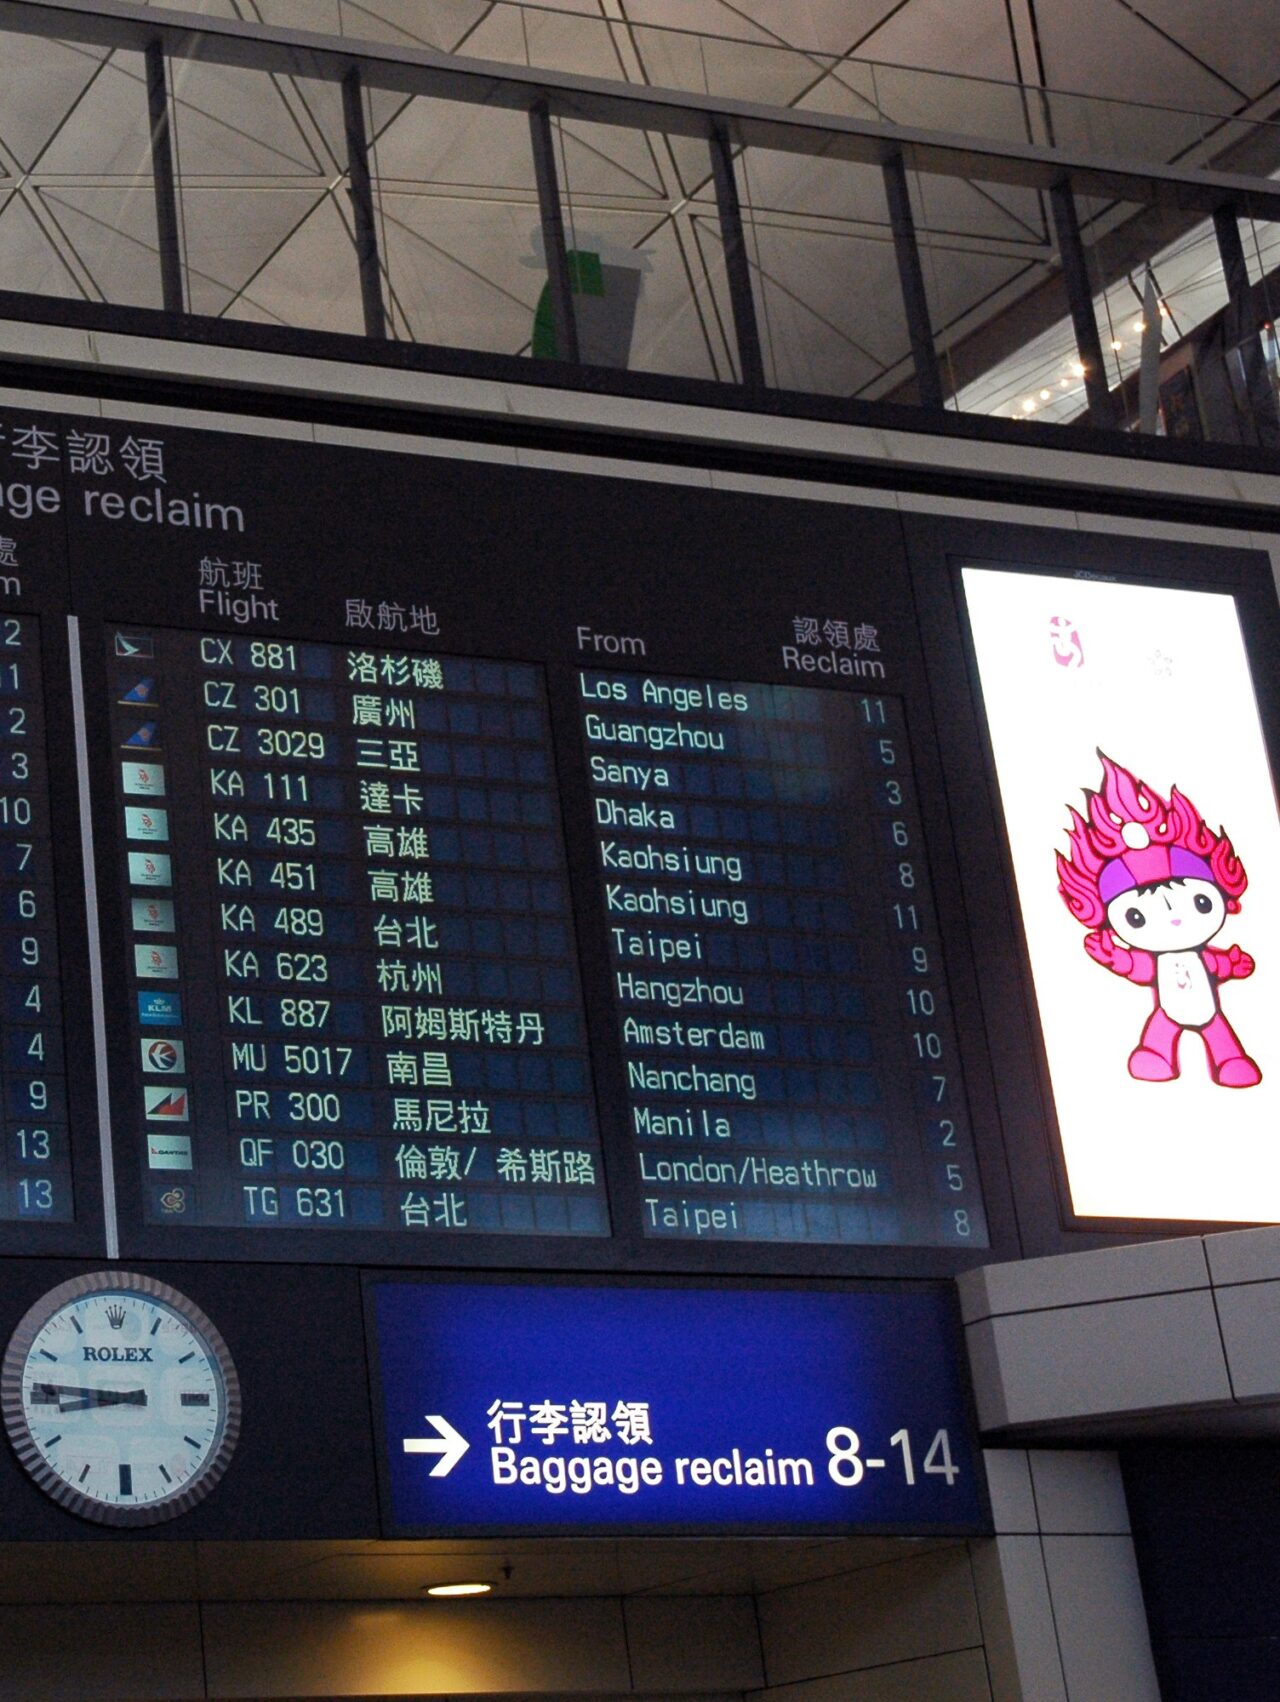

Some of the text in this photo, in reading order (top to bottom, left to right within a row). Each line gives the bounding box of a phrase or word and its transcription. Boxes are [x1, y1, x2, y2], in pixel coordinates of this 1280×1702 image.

[84, 488, 244, 532] reclaim
[199, 556, 264, 590] 航班
[199, 588, 279, 623] Flight
[577, 626, 646, 655] From
[792, 615, 881, 652] 認領處
[200, 638, 295, 671] CX 881
[347, 651, 444, 689] 洛杉磯
[782, 645, 885, 678] Reclaim
[204, 681, 299, 714] CZ 301
[580, 672, 748, 711] Los Angeles
[9, 707, 26, 735] 2
[352, 695, 415, 729] 廣州
[207, 724, 325, 759] CZ 3029
[585, 714, 724, 750] Guangzhou
[11, 752, 28, 779] 3
[357, 739, 420, 772] 三亞
[880, 740, 895, 764] 5
[211, 769, 307, 801] KA 111
[590, 756, 669, 790] Sanya
[360, 780, 423, 815] 達卡
[886, 781, 902, 805] 3
[0, 796, 31, 825] 10
[595, 798, 675, 829] Dhaka
[214, 812, 315, 846] KA 435
[363, 824, 429, 859] 高雄
[893, 822, 908, 846] 6
[17, 843, 32, 870] 7
[600, 841, 742, 882] Kaohsiung
[217, 858, 315, 890] KA 451
[367, 869, 434, 904] 高雄
[19, 890, 36, 918] 6
[221, 903, 324, 936] KA 489
[606, 884, 749, 925] Kaohsiung
[373, 914, 439, 948] 台北
[611, 928, 701, 963] Taipei
[21, 937, 39, 965] 9
[225, 949, 328, 982] KA 623
[912, 947, 928, 972] 9
[376, 958, 442, 994] 杭州
[617, 972, 743, 1007] Hangzhou
[25, 985, 41, 1012] 4
[148, 1004, 171, 1012] KLM
[228, 996, 330, 1028] KL 887
[907, 989, 934, 1015] 10
[381, 1005, 544, 1045] 阿姆斯特丹
[623, 1017, 765, 1050] Amsterdam
[27, 1033, 44, 1061] 4
[232, 1042, 352, 1075] MU 5017
[914, 1033, 941, 1058] 10
[386, 1051, 452, 1086] 南昌
[628, 1061, 756, 1100] Nanchang
[29, 1081, 47, 1110] 9
[933, 1076, 946, 1101] 7
[235, 1090, 340, 1122] PR 300
[393, 1098, 491, 1134] 馬尼拉
[633, 1107, 730, 1137] Manila
[17, 1129, 50, 1159] 13
[940, 1120, 956, 1146] 2
[240, 1138, 344, 1170] QF 030
[639, 1152, 877, 1187] London/Heathrow
[20, 1179, 53, 1209] 13
[243, 1186, 344, 1217] TG 631
[400, 1192, 467, 1227] 台北
[645, 1198, 737, 1234] Taipei
[83, 1346, 153, 1362] ROLEX
[487, 1399, 653, 1445] 行李認領
[491, 1426, 959, 1494] Baggage reclaim 8-14
